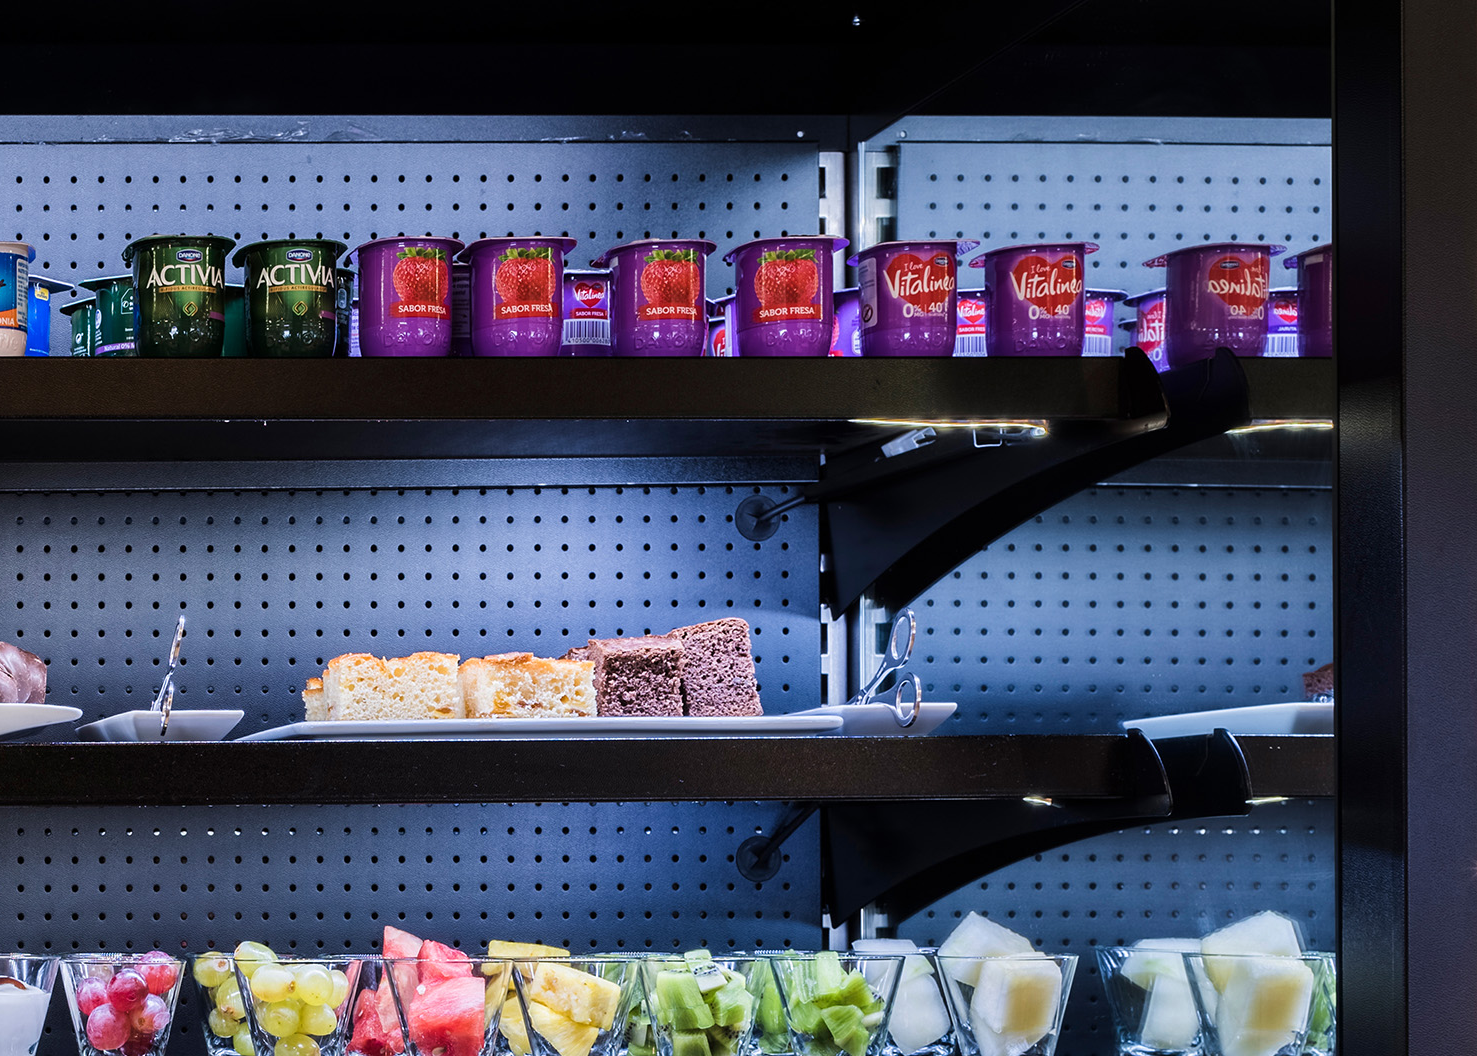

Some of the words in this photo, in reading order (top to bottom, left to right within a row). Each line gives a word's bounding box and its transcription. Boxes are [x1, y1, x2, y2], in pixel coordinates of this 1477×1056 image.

[909, 261, 923, 270] love
[1036, 264, 1051, 272] love
[146, 264, 223, 289] ACTIVIA
[256, 263, 334, 289] ACTIVIA
[883, 265, 955, 299] Vitalinea
[1010, 268, 1082, 301] Vitalinea
[398, 304, 427, 313] SABOR
[427, 305, 446, 315] FRESA
[501, 304, 530, 314] SABOR
[531, 303, 553, 313] FRESA
[646, 306, 675, 316] SABOR
[676, 306, 697, 315] FRESA
[759, 307, 788, 318] SABOR
[790, 306, 814, 315] FRESA
